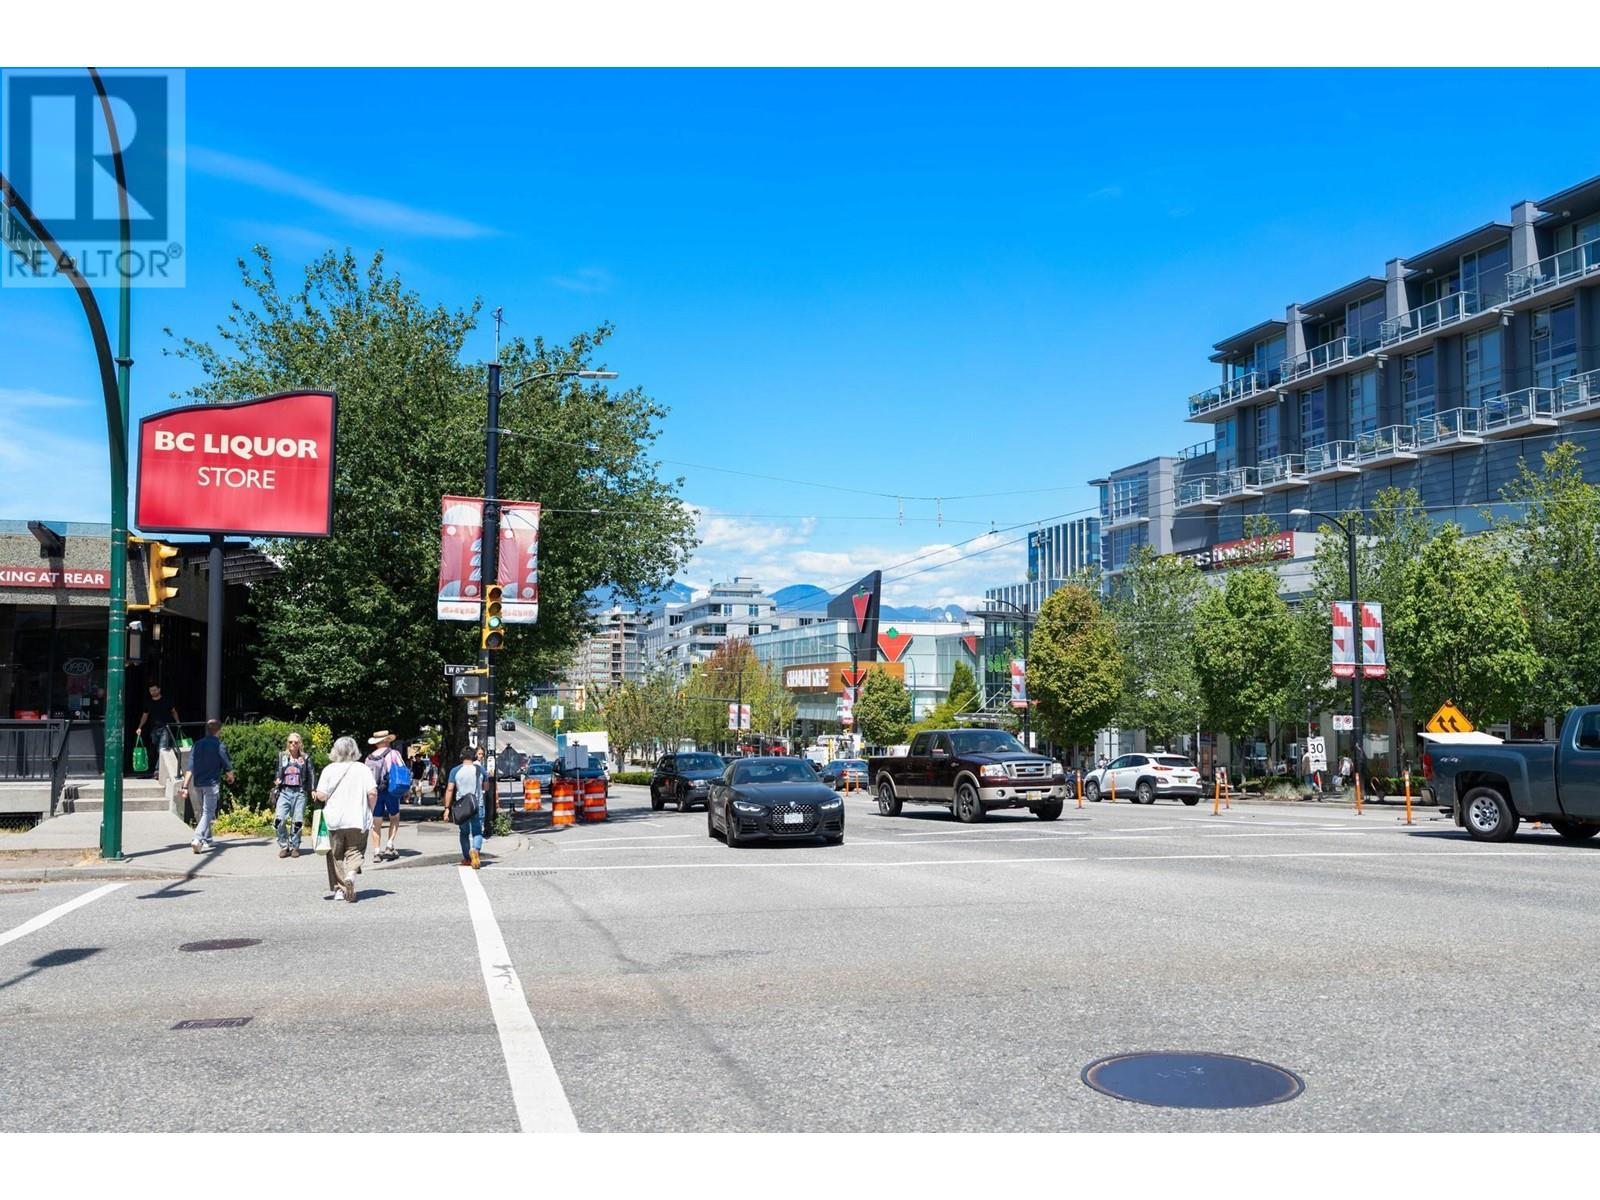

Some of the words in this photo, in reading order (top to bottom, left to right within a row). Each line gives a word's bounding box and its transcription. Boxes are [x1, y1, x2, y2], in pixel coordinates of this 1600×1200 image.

[154, 430, 195, 452] BC
[204, 433, 318, 460] LIQUOR
[197, 466, 276, 490] STORE
[38, 572, 60, 583] AT
[64, 573, 105, 584] REAR
[1310, 743, 1324, 754] 30
